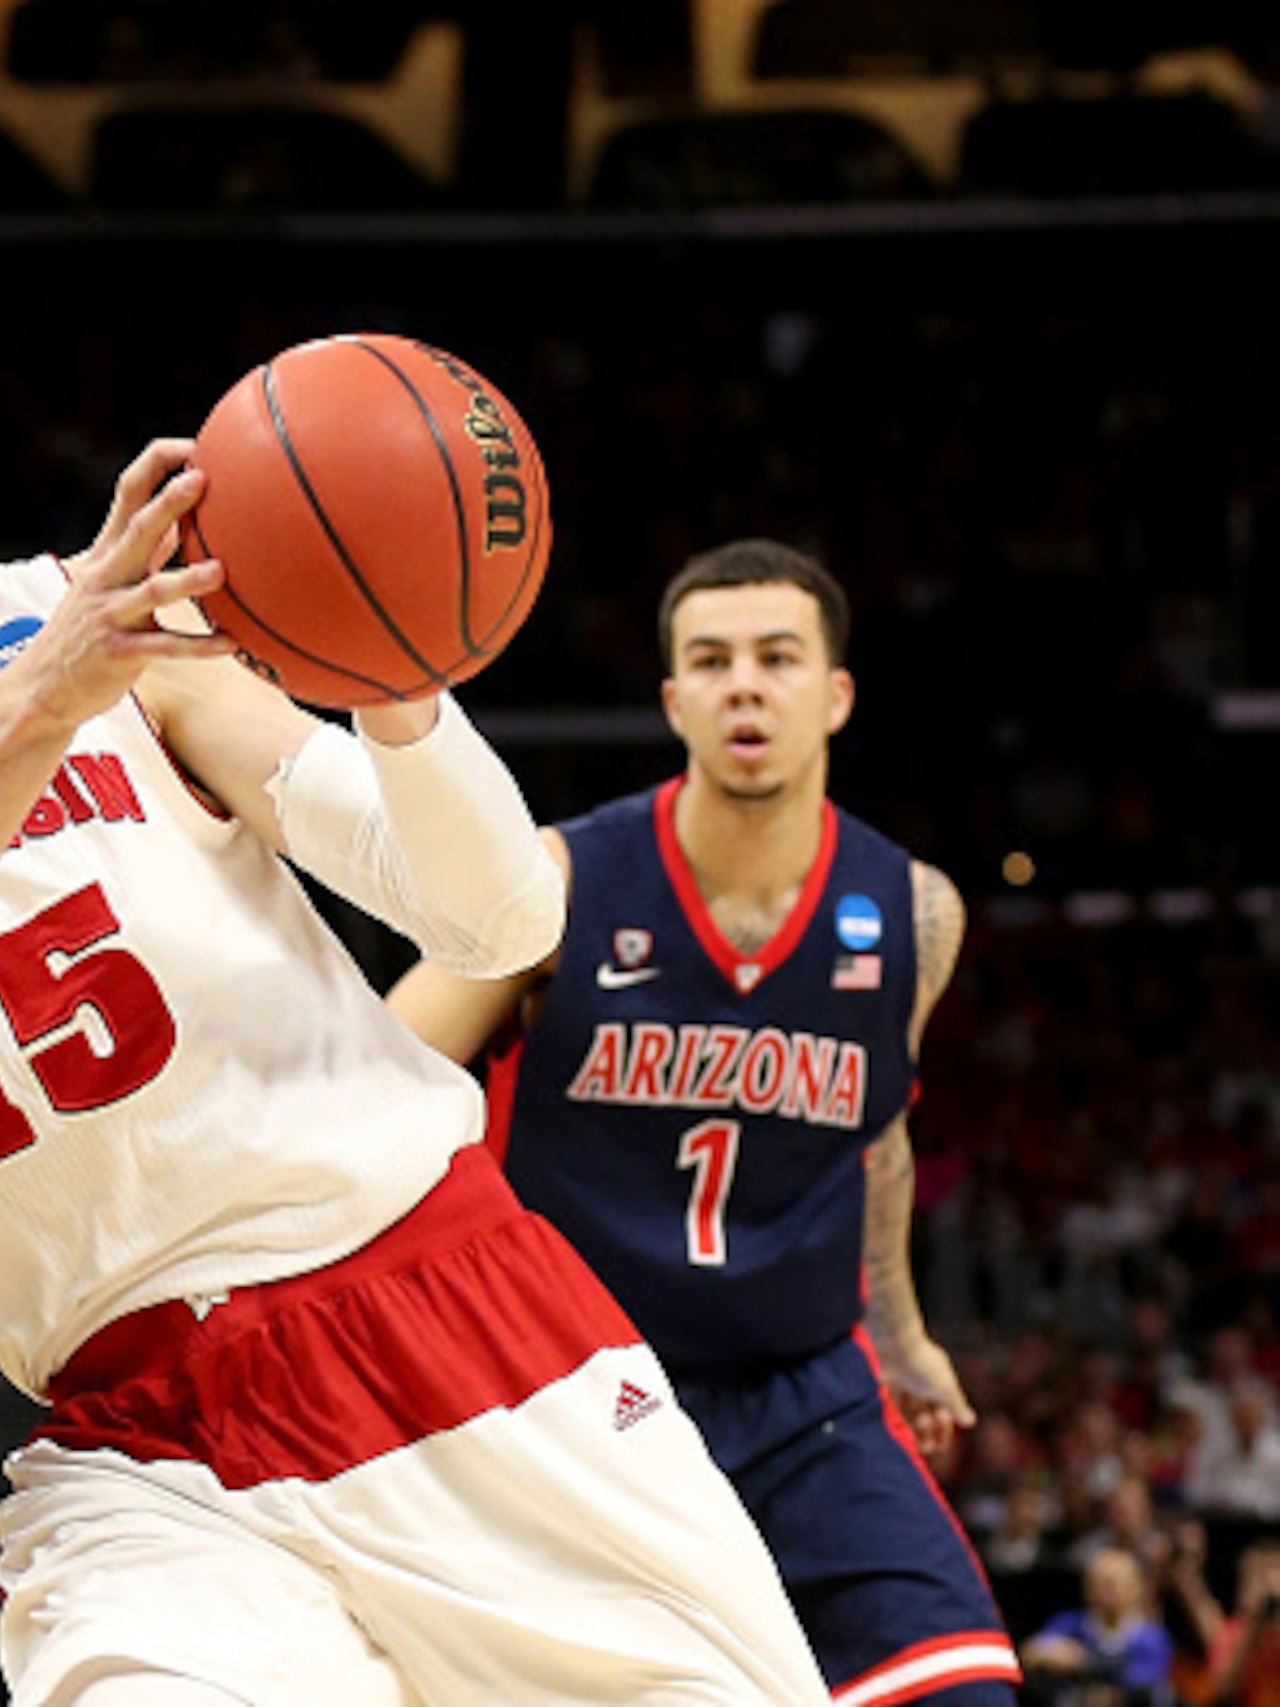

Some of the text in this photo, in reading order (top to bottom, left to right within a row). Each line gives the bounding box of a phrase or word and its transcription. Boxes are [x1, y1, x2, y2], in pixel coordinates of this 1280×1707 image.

[8, 750, 147, 846] SIN
[567, 1022, 867, 1128] ARIZONA
[676, 1117, 741, 1266] 1
